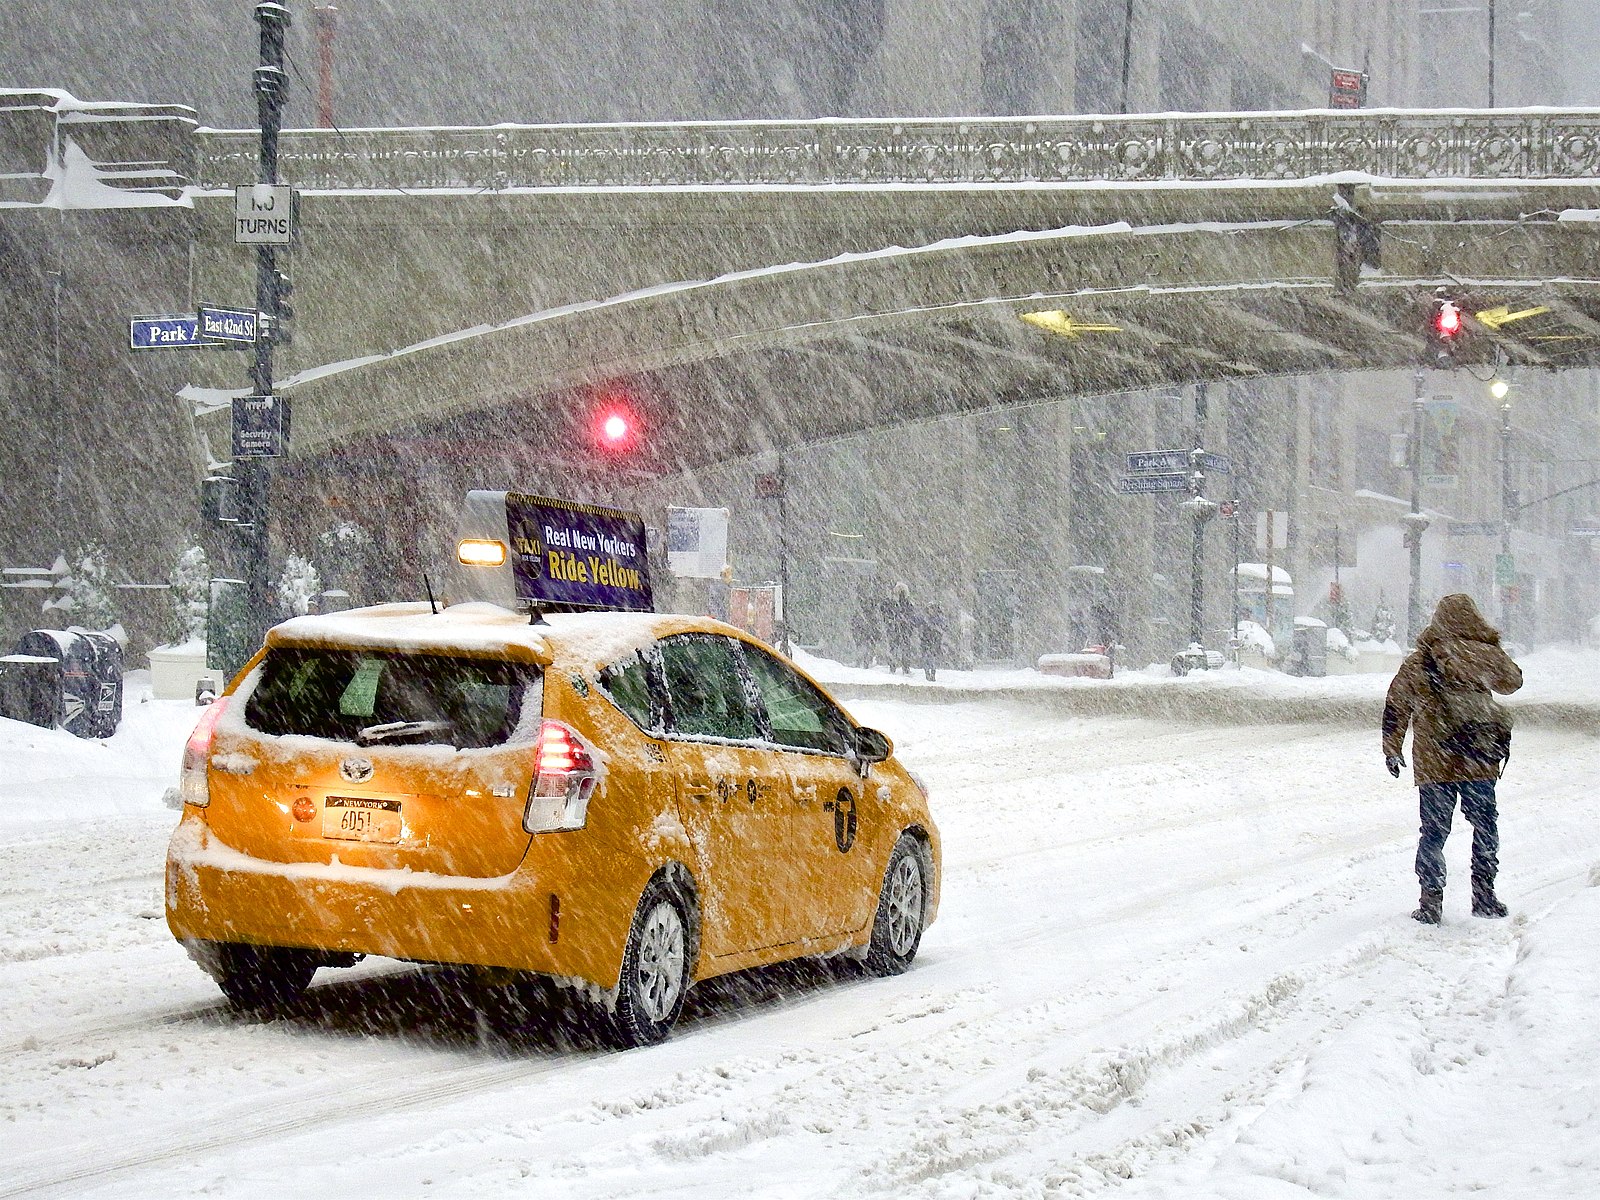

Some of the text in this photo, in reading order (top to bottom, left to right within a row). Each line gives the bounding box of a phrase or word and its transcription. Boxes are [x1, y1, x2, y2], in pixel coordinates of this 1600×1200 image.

[251, 195, 275, 211] NO
[238, 219, 287, 234] TURNS
[149, 325, 188, 342] Park
[205, 315, 254, 337] East 42nd St
[240, 430, 271, 439] Security
[241, 440, 271, 448] Camera
[1138, 458, 1159, 468] Park
[518, 537, 541, 555] TAXI
[545, 525, 636, 557] Real New Yorkers
[548, 550, 588, 583] Ride
[363, 801, 383, 809] YORK
